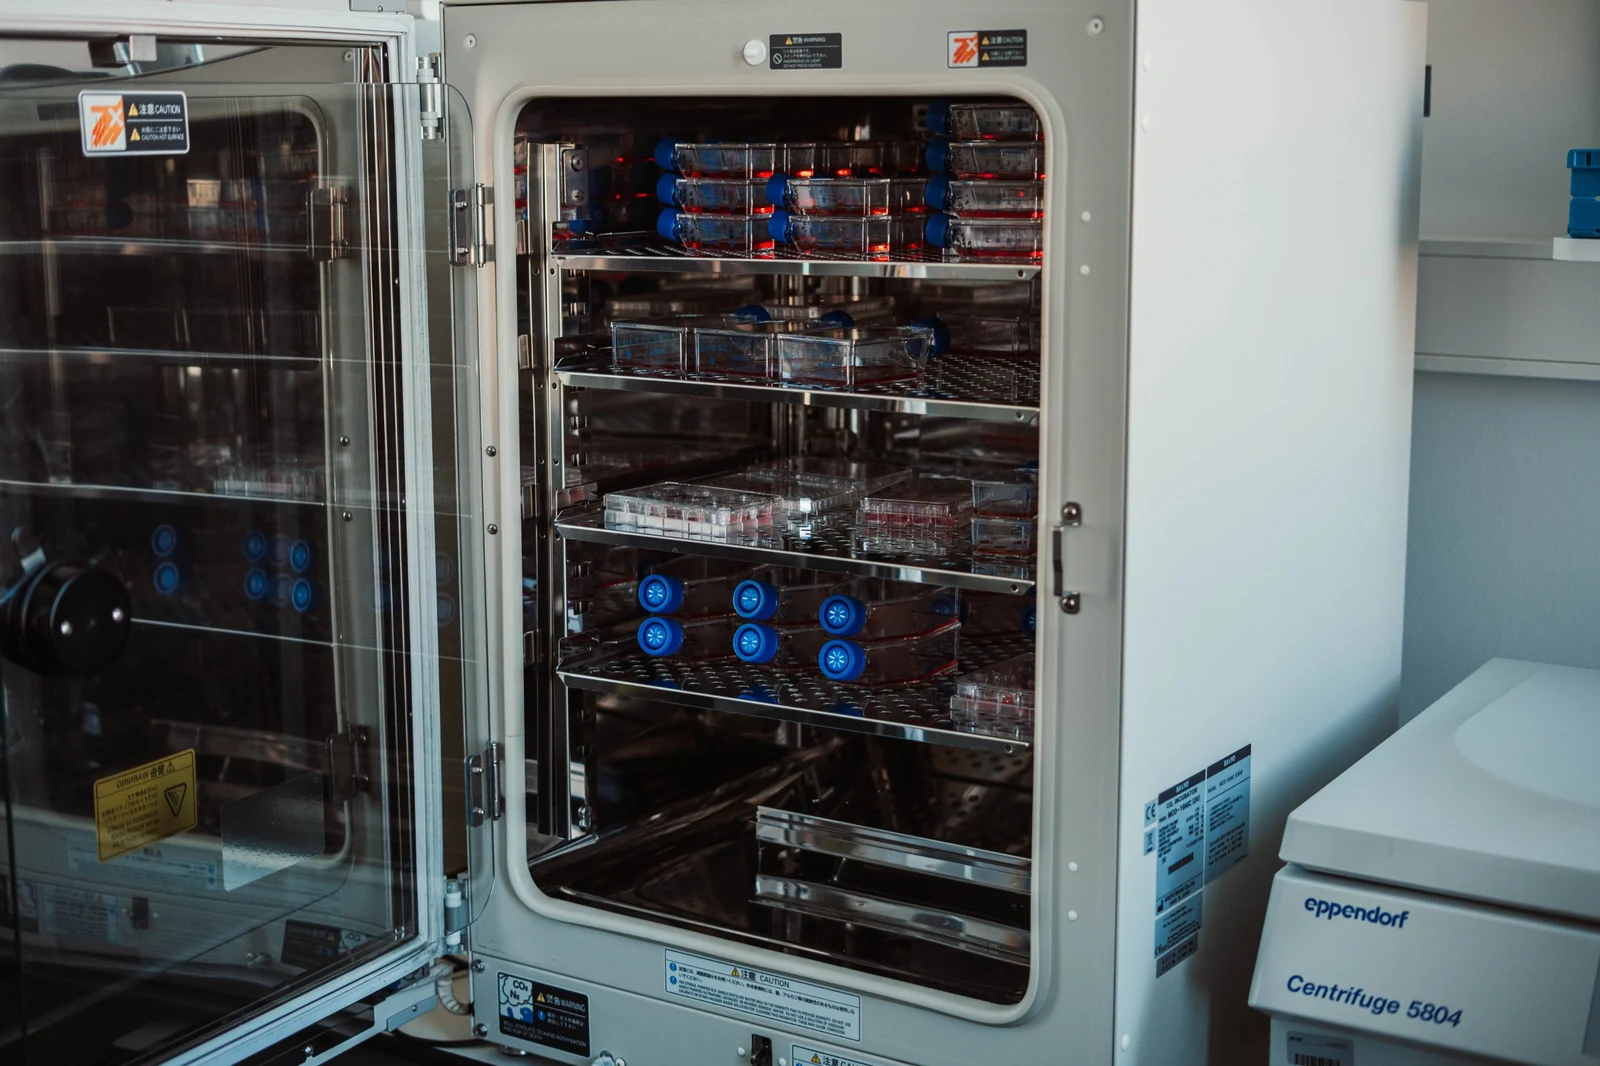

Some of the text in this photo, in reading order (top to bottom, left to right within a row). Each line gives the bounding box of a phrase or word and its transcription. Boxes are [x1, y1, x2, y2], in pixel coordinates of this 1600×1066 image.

[155, 105, 181, 114] CAUTION
[1304, 898, 1409, 928] eppendorf
[741, 970, 756, 981] 注意
[760, 975, 790, 988] CAUTION
[510, 990, 519, 1000] N2
[1287, 974, 1463, 1028] Centrifuge 5804
[561, 999, 585, 1012] WARNING
